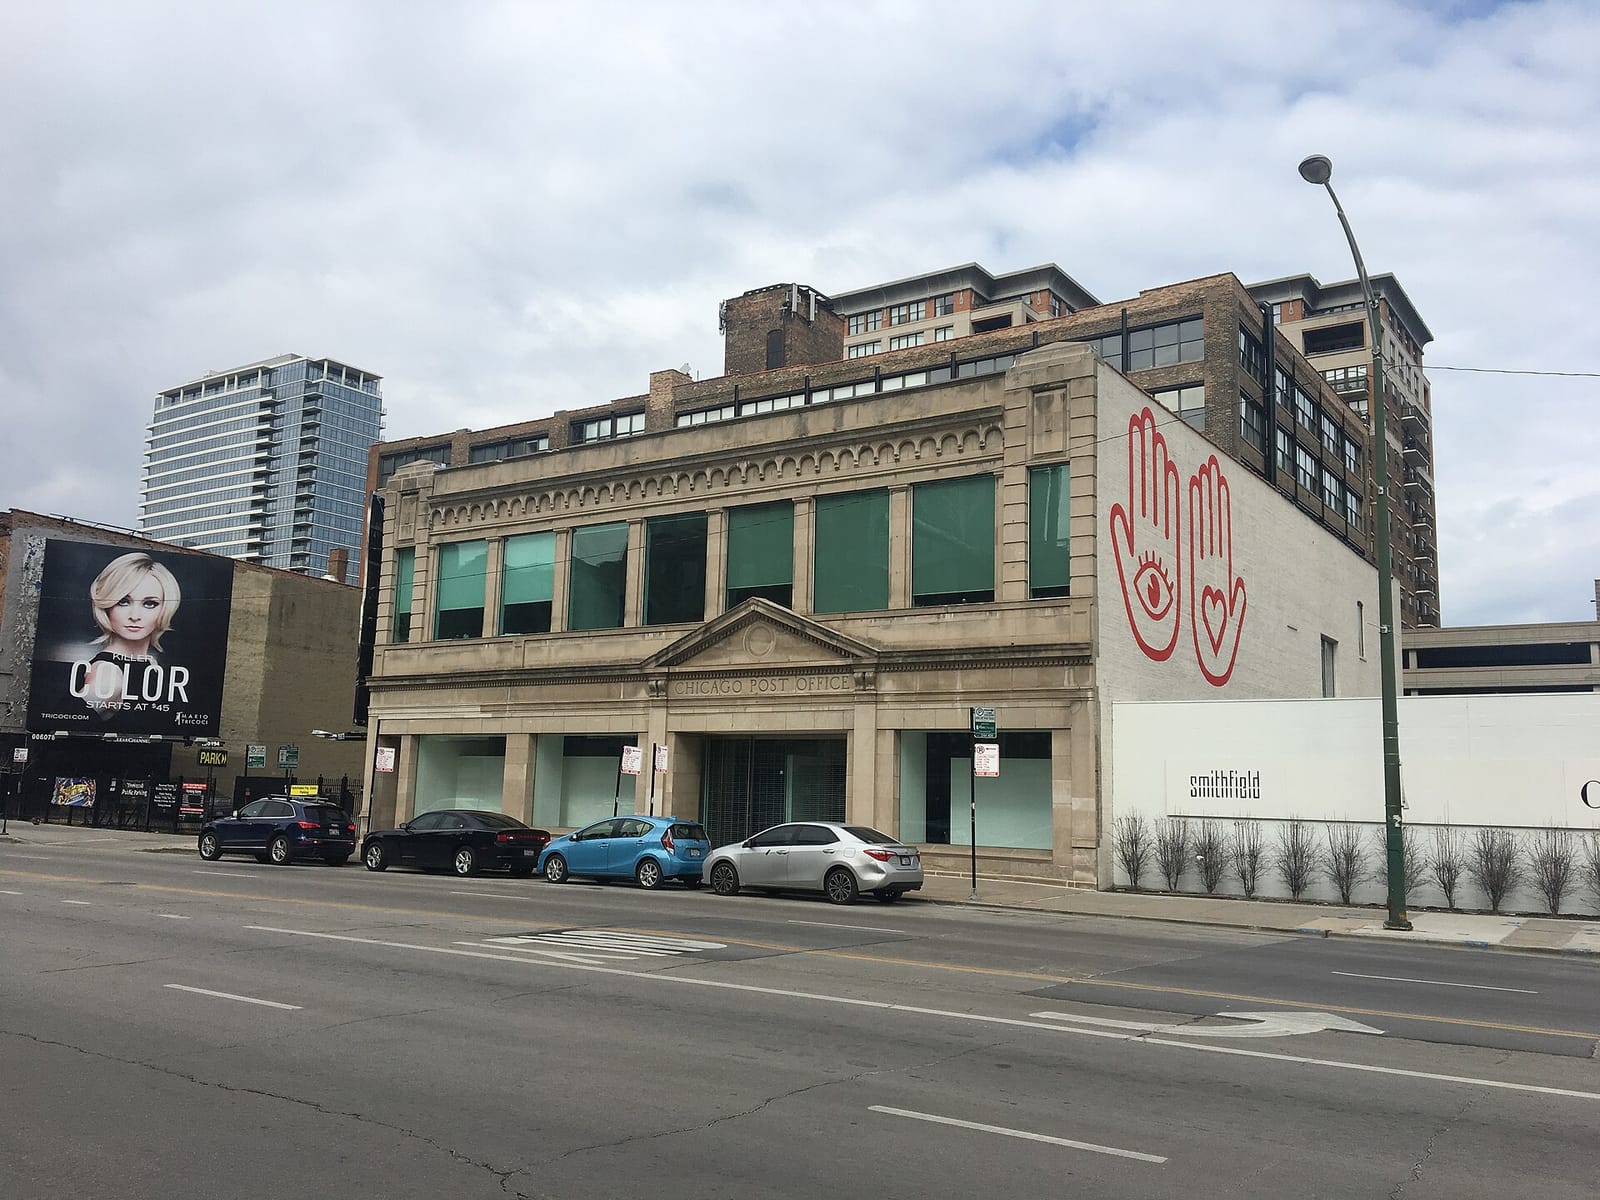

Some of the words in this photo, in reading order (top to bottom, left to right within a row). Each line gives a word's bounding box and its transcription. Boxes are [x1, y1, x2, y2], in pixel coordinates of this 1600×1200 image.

[112, 653, 153, 663] KILLER
[69, 659, 189, 703] COLOR
[675, 680, 743, 695] CHICAGO
[750, 678, 789, 692] POST
[796, 675, 850, 691] OFFICE
[86, 700, 131, 711] STARTS
[134, 703, 148, 711] AT
[151, 703, 170, 712] $45
[41, 712, 89, 720] TRICOCI.COM
[1190, 769, 1260, 799] smithfield
